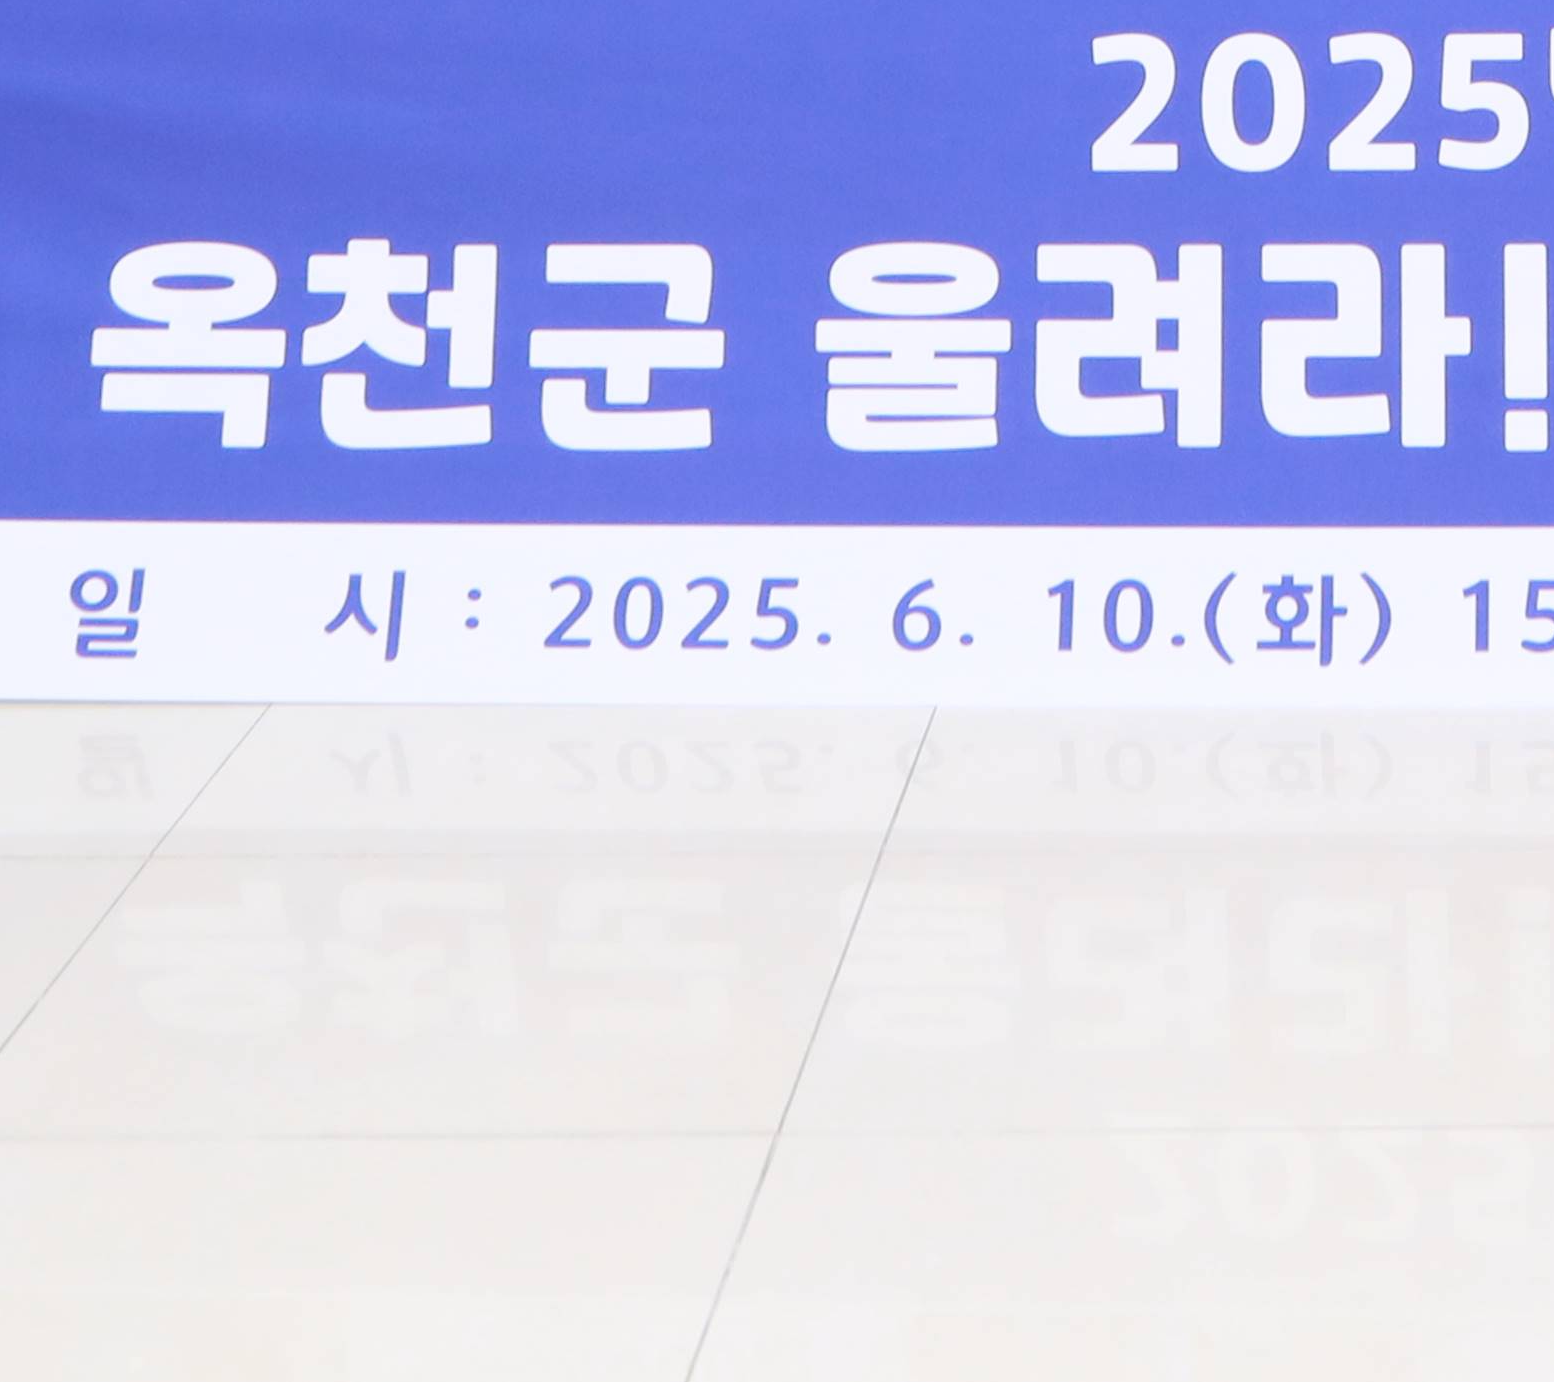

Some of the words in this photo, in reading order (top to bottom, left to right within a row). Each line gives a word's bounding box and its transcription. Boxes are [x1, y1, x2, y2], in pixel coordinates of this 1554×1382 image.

[90, 239, 725, 450] 옥천군
[815, 241, 1549, 452] 울려라!
[543, 575, 833, 651] 2025.
[891, 578, 975, 652] 6.
[1047, 572, 1393, 667] 10.(화)
